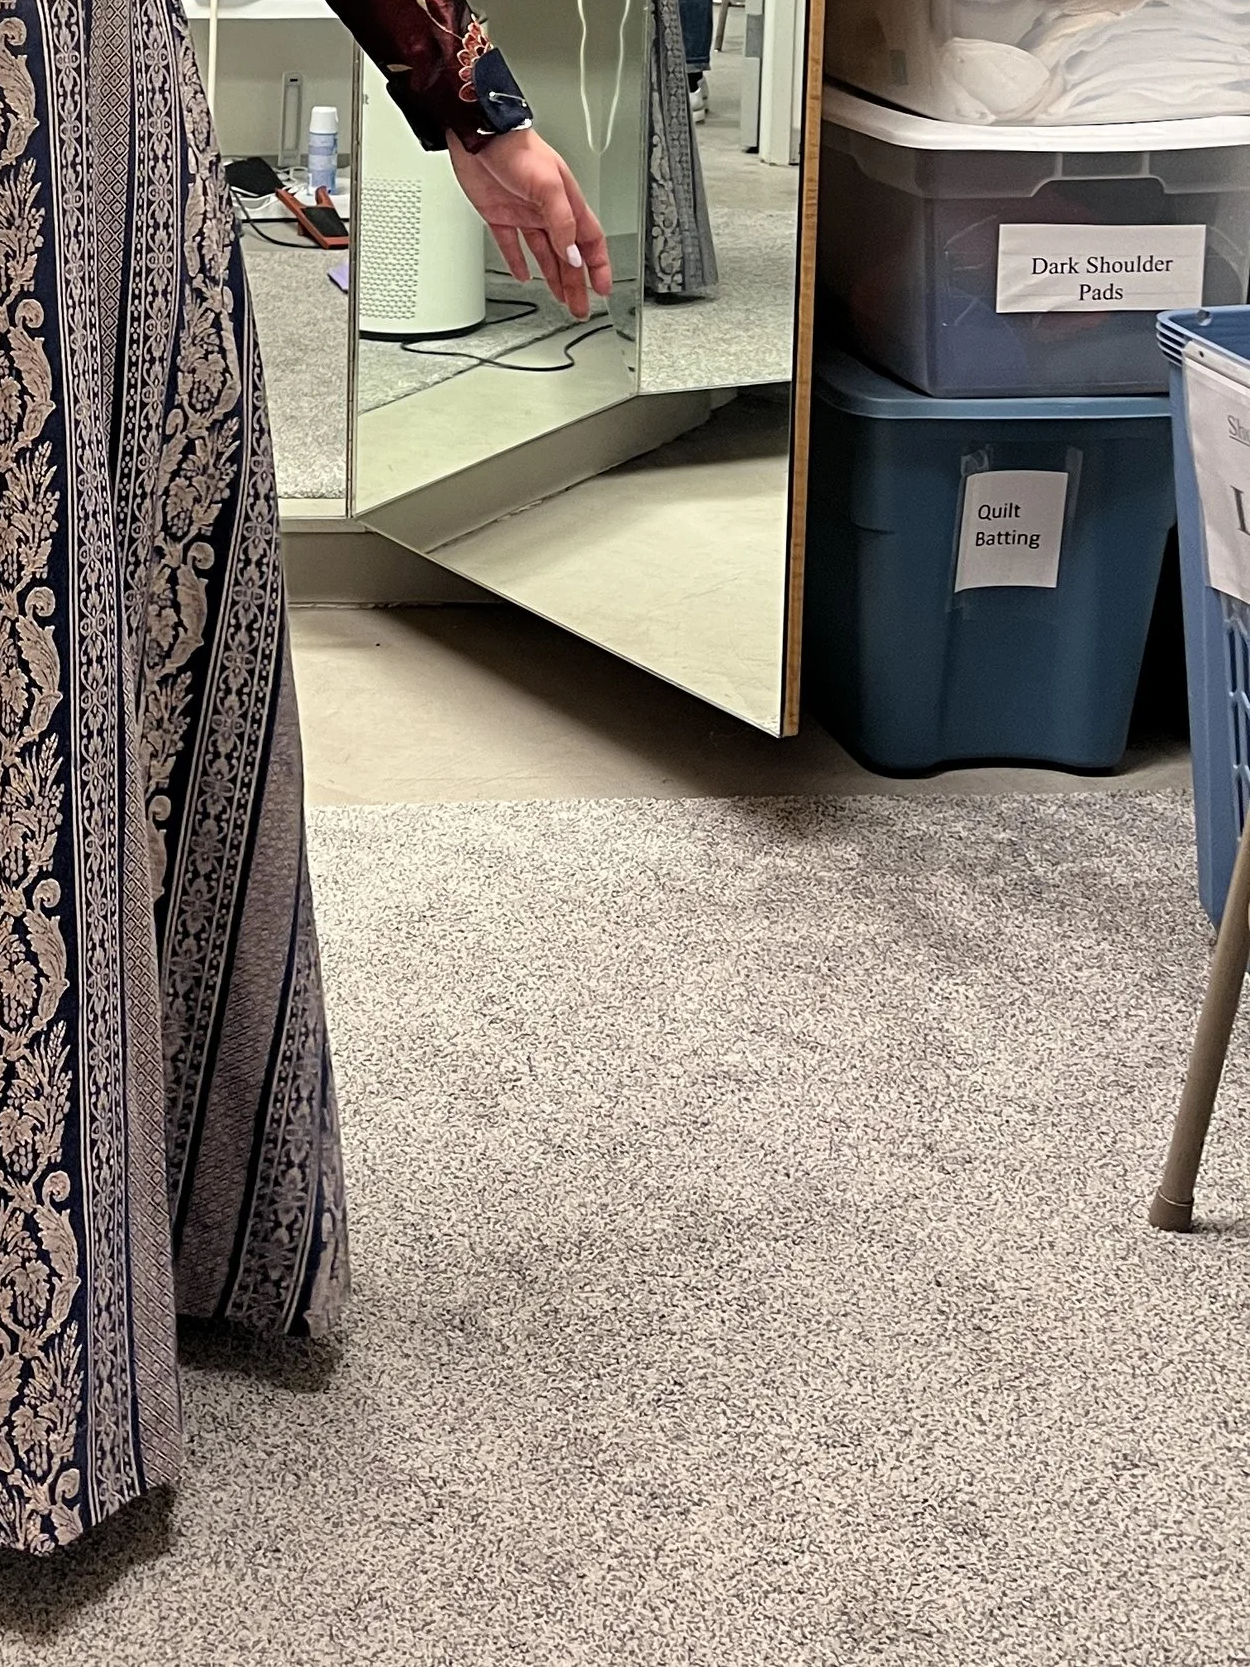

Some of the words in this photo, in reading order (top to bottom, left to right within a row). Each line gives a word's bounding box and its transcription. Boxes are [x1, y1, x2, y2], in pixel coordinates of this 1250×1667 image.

[1031, 256, 1080, 275] Dark
[1086, 254, 1174, 274] Shoulder
[1078, 282, 1124, 301] Pads
[978, 502, 1021, 521] Quilt
[975, 529, 1041, 550] Batting
